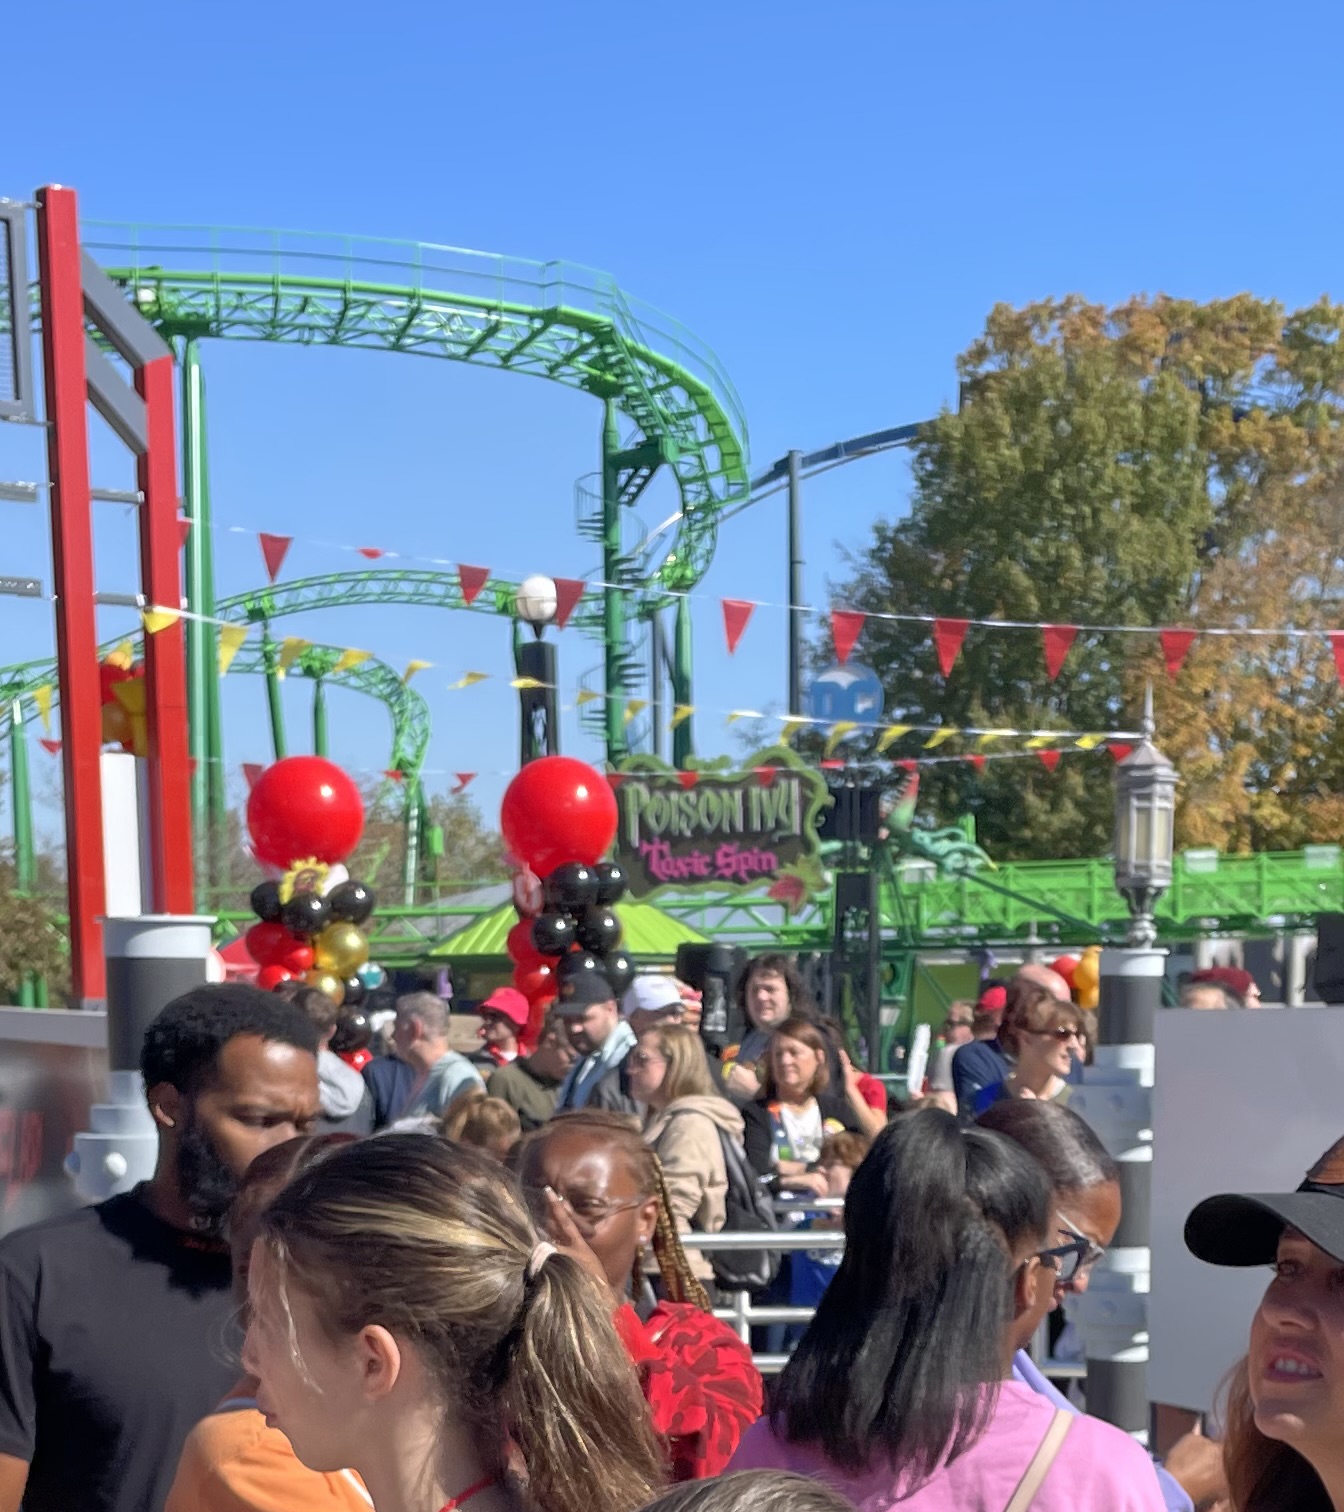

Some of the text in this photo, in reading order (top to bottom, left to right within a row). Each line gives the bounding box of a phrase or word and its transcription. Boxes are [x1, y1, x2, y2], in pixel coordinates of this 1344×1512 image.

[809, 681, 880, 723] DC
[623, 777, 803, 849] POISON IVY
[640, 837, 779, 885] Toxic Spin
